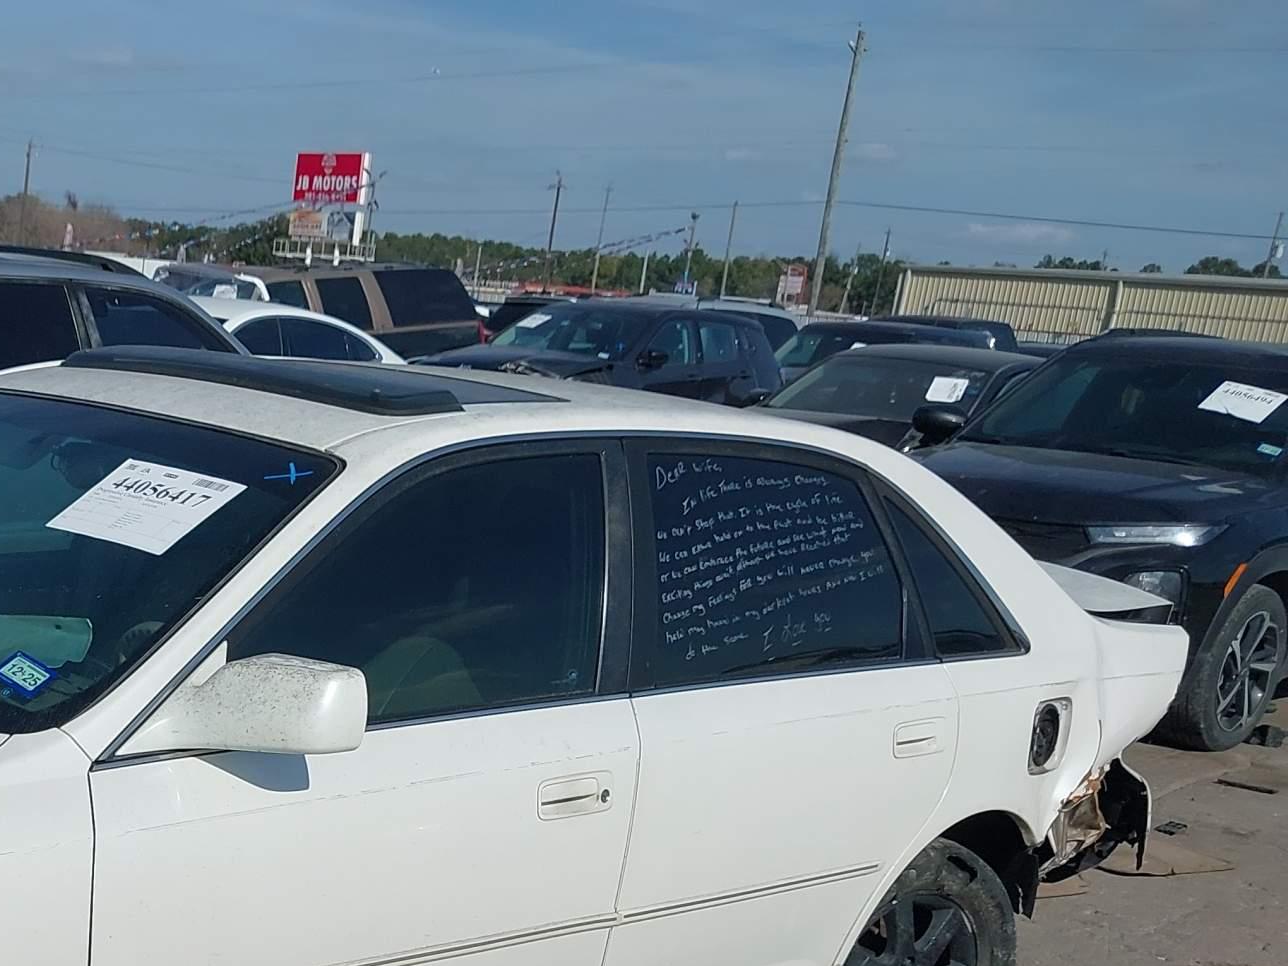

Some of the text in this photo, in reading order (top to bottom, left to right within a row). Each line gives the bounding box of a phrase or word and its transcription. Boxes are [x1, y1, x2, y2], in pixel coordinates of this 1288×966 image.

[312, 175, 358, 192] MOTORS
[112, 476, 213, 508] 44056417
[7, 664, 42, 687] 12 25
